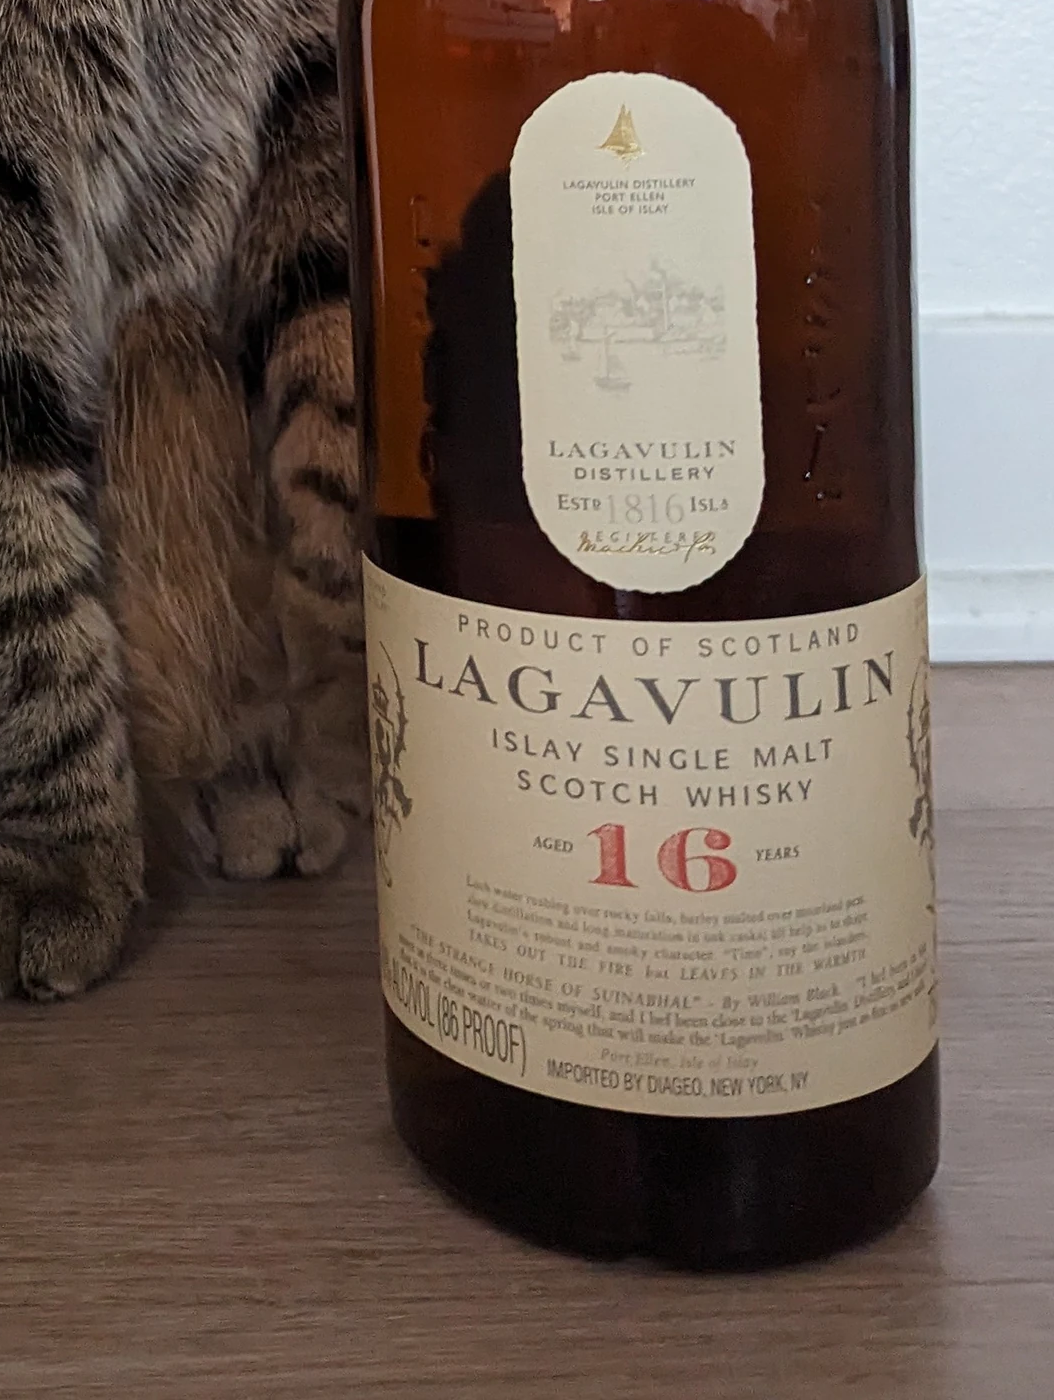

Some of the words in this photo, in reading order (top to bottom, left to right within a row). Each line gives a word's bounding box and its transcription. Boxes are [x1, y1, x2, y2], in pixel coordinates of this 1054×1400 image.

[563, 179, 629, 190] LAGAVULIN
[632, 178, 696, 189] DISTILLERY
[595, 192, 626, 202] PORT
[630, 191, 665, 201] ELLEN
[592, 205, 614, 215] ISLE
[618, 205, 635, 215] OF
[638, 204, 669, 215] ISLAY
[549, 440, 736, 460] LAGAVULIN
[574, 466, 715, 481] DISTILLERY
[607, 493, 685, 525] 1816
[458, 613, 606, 653] PRODUCT
[632, 637, 672, 657] OF
[698, 623, 859, 658] SCOTLAND
[414, 637, 894, 725] LAGAVULIN
[493, 728, 583, 762] ISLAY
[604, 746, 730, 770] SINGLE
[753, 738, 833, 769] MALT
[517, 769, 658, 806] SCOTCH
[686, 778, 812, 808] WHISKY
[533, 835, 574, 853] AGED
[587, 822, 737, 893] 16
[755, 845, 800, 861] YEARS
[517, 944, 546, 961] OUT
[437, 991, 459, 1042] (86
[461, 1004, 526, 1077] PROOF)
[547, 1057, 620, 1089] IMPORTED
[624, 1072, 644, 1091] BY
[710, 1077, 744, 1097] NEW
[790, 1070, 809, 1091] NY
